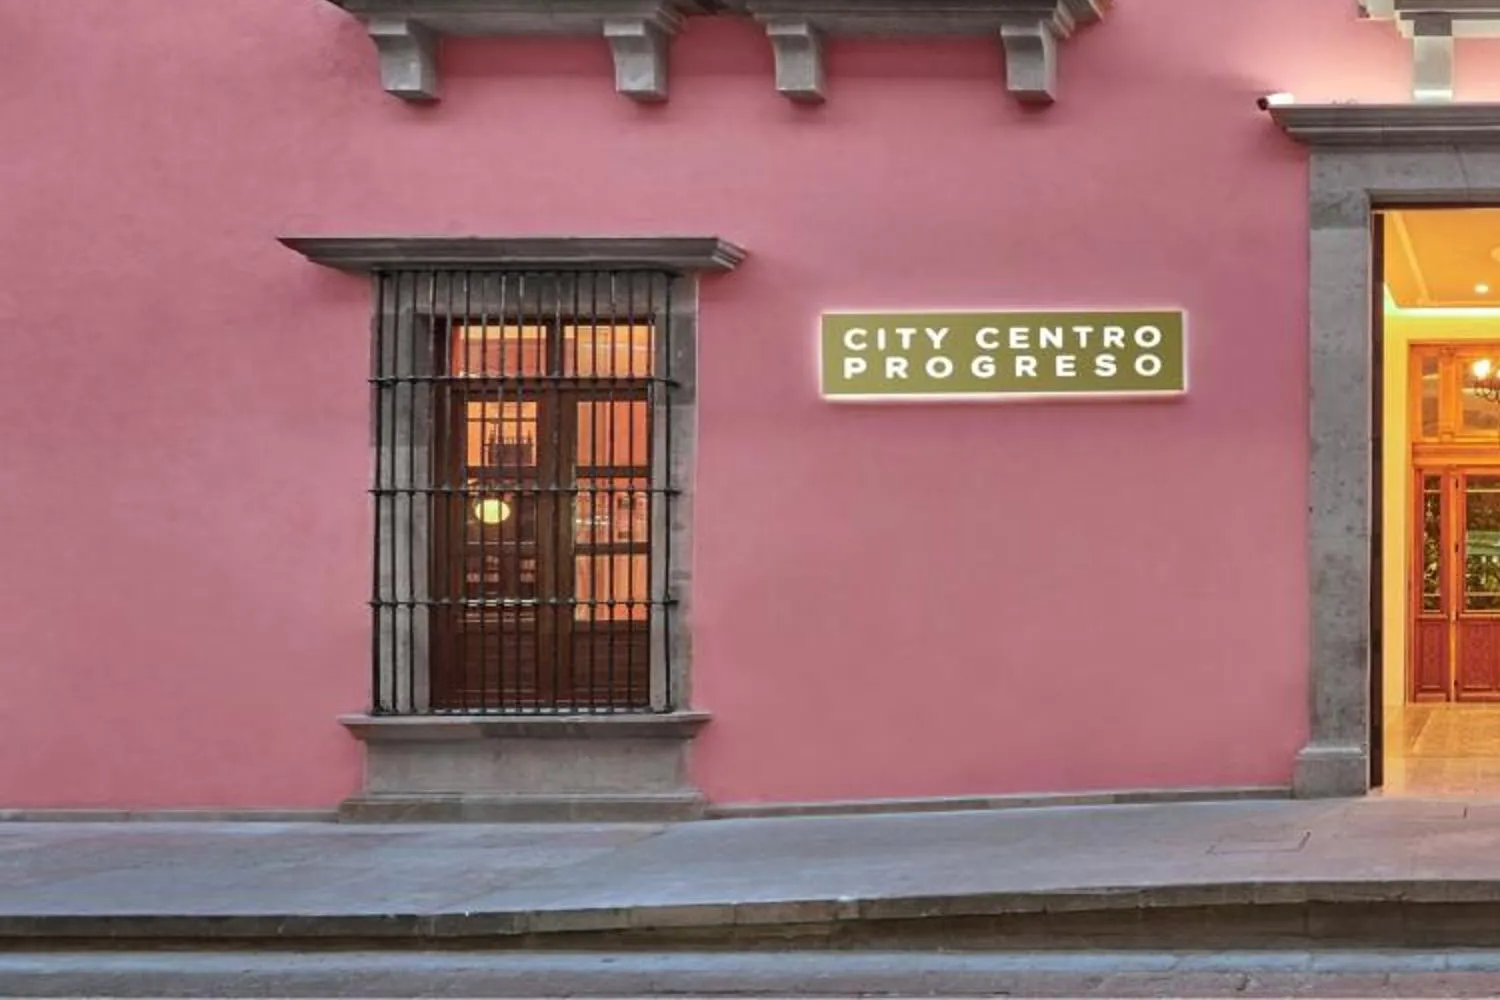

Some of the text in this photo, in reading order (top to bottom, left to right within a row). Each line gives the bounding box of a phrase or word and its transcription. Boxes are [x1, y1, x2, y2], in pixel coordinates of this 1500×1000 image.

[843, 325, 1162, 351] CITY CENTRO
[843, 354, 1162, 379] PROGRESO
